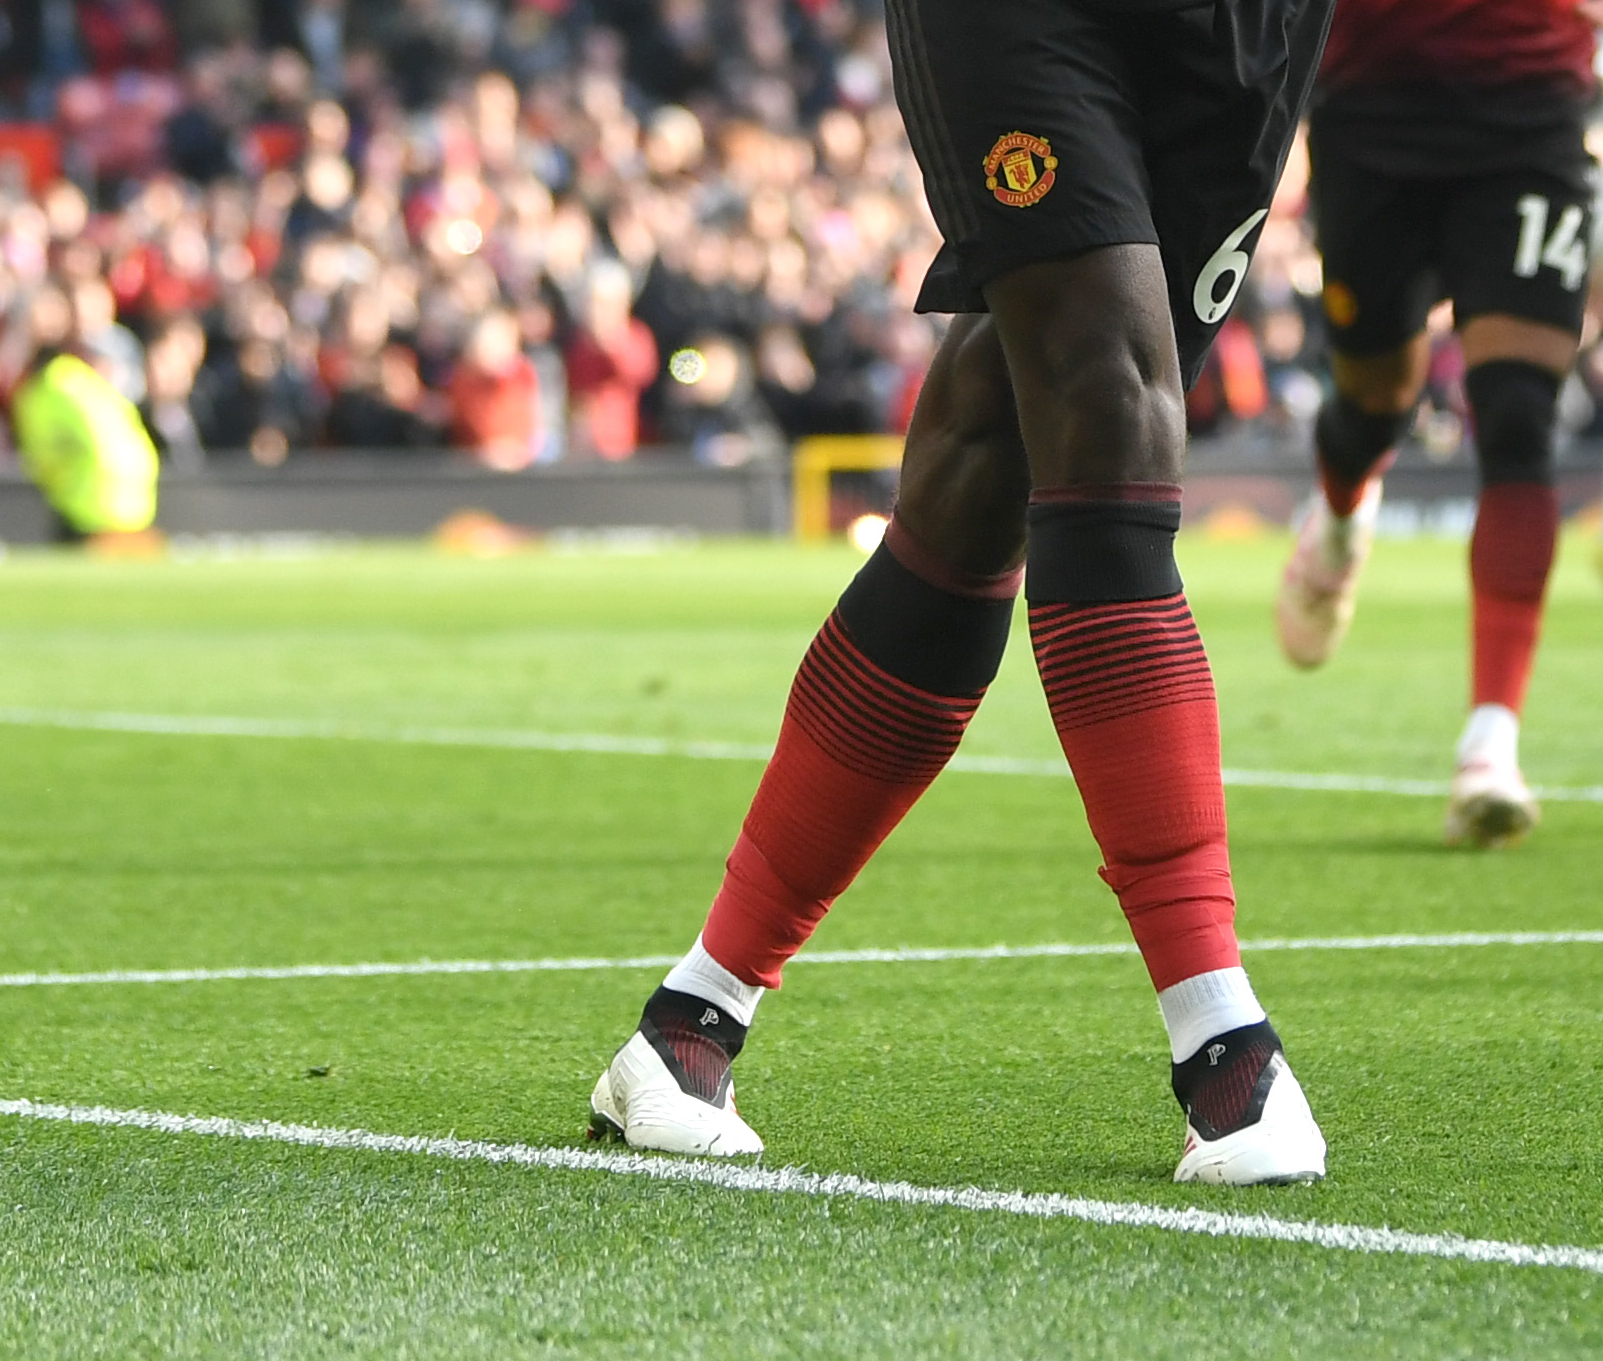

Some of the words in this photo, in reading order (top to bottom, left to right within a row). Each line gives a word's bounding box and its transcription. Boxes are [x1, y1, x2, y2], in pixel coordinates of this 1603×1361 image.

[988, 135, 1046, 170] MANCHESTER
[1006, 183, 1048, 204] UNITED
[1193, 208, 1269, 323] 6
[1513, 193, 1586, 291] 14
